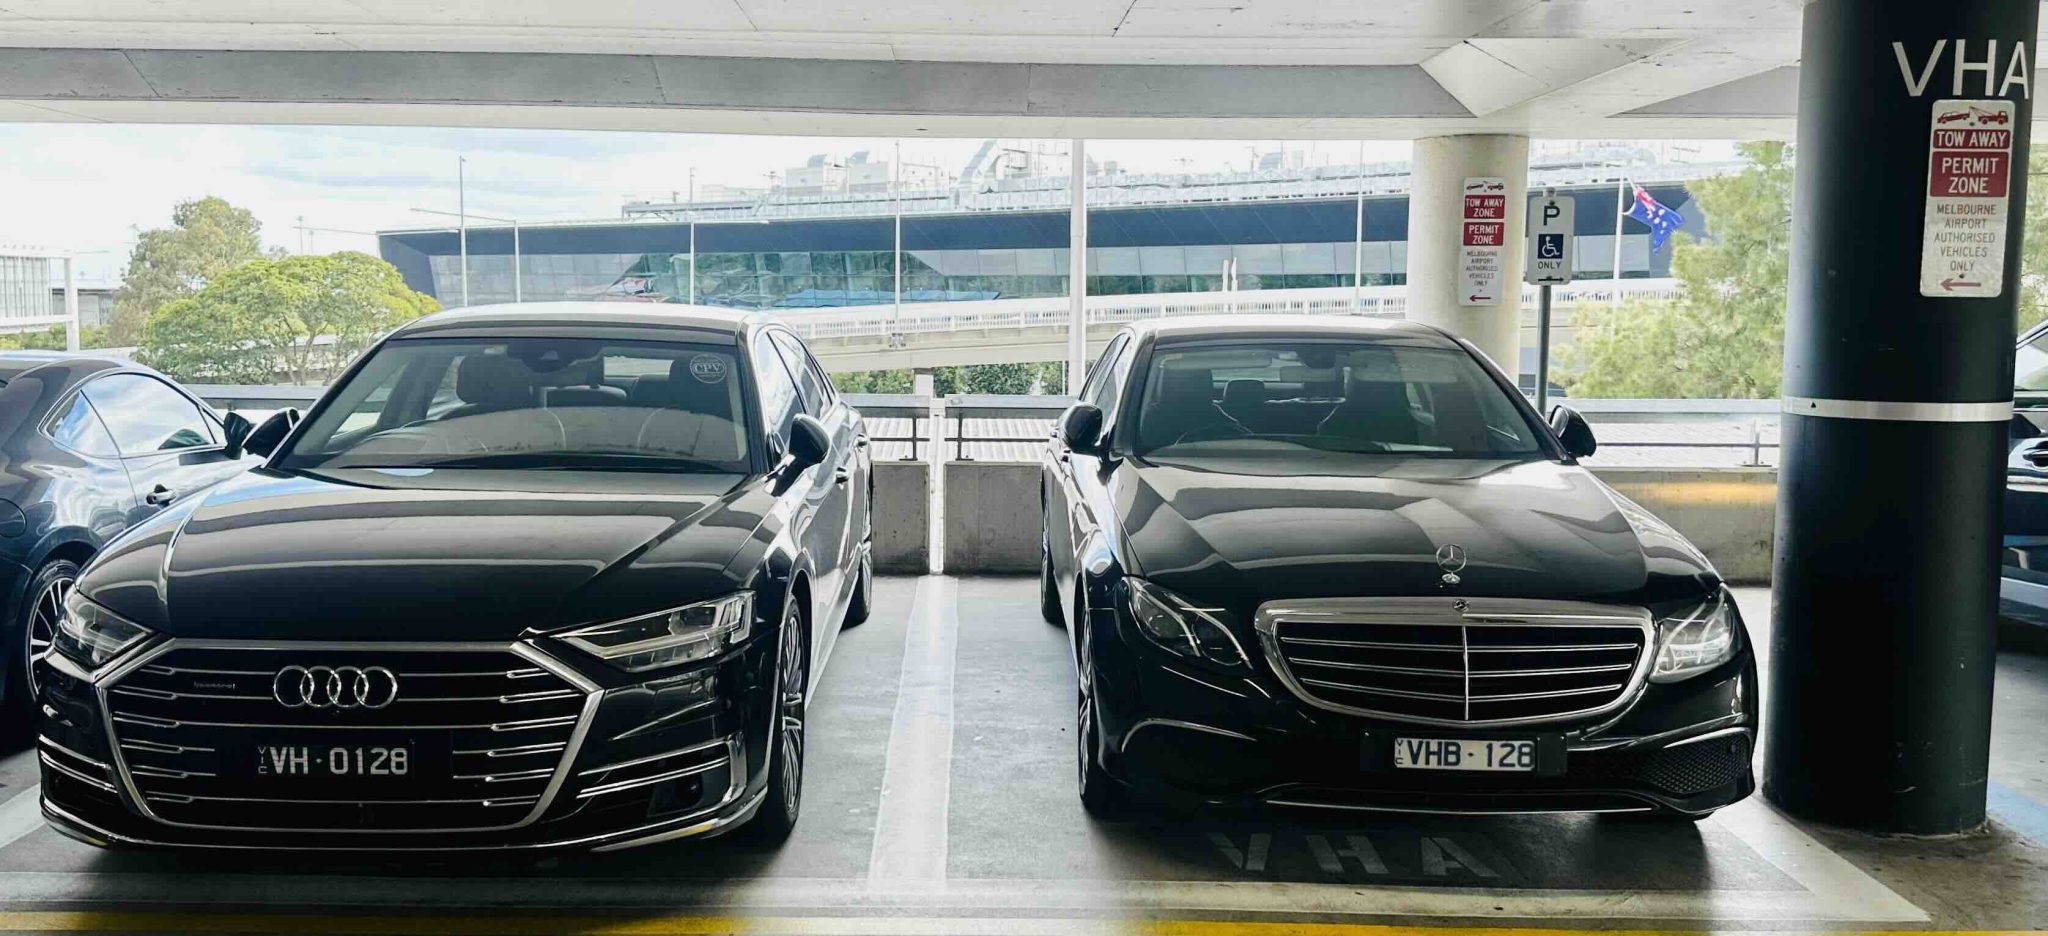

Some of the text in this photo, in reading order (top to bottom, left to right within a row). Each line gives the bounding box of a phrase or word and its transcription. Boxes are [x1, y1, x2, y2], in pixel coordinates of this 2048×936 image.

[1892, 39, 2030, 99] VHA
[1936, 130, 2008, 147] TOW AWAY
[1942, 157, 1999, 174] PERMIT
[1948, 177, 1988, 194] ZONE
[1466, 198, 1504, 207] TOW AWAY
[1473, 208, 1495, 217] ZONE
[1936, 204, 1997, 215] MELBOURNE
[1543, 205, 1560, 226] P
[1468, 224, 1500, 234] PERMIT
[1944, 218, 1987, 229] AIRPORT
[1472, 235, 1494, 245] ZONE
[1934, 232, 1996, 243] AUTHORISED
[1940, 246, 1988, 257] VEHICLES
[1537, 261, 1562, 269] ONLY
[1950, 260, 1976, 272] ONLY
